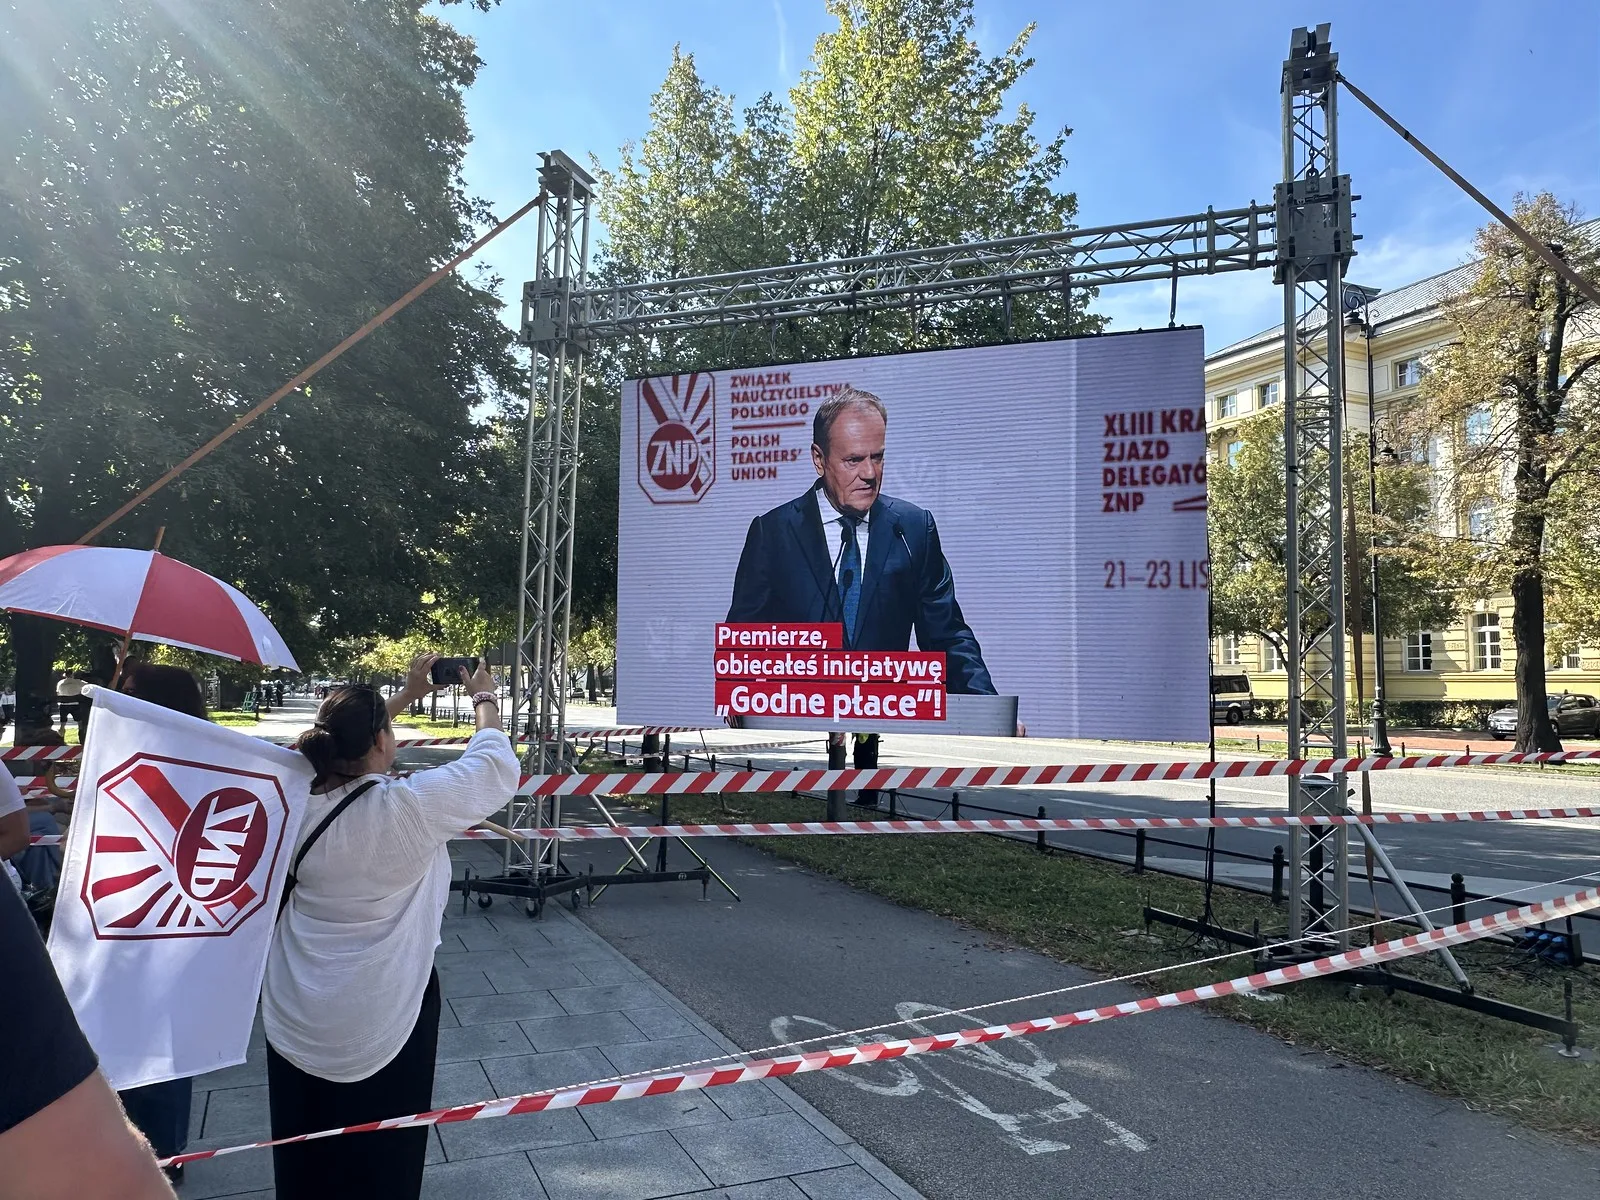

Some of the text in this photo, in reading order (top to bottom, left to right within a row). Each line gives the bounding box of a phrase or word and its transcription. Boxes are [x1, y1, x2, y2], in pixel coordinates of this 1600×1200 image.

[730, 373, 791, 389] ZWIĄZEK
[731, 402, 809, 419] POLSKIEGO
[1103, 411, 1153, 437] XLIII
[731, 434, 780, 449] POLISH
[1103, 440, 1170, 463] ZJAZD
[649, 439, 698, 476] ZNP
[731, 466, 777, 481] UNION
[1103, 492, 1144, 512] ZNP
[718, 625, 828, 649] Premierze,
[715, 653, 942, 684] obiecałeś inicjatywę
